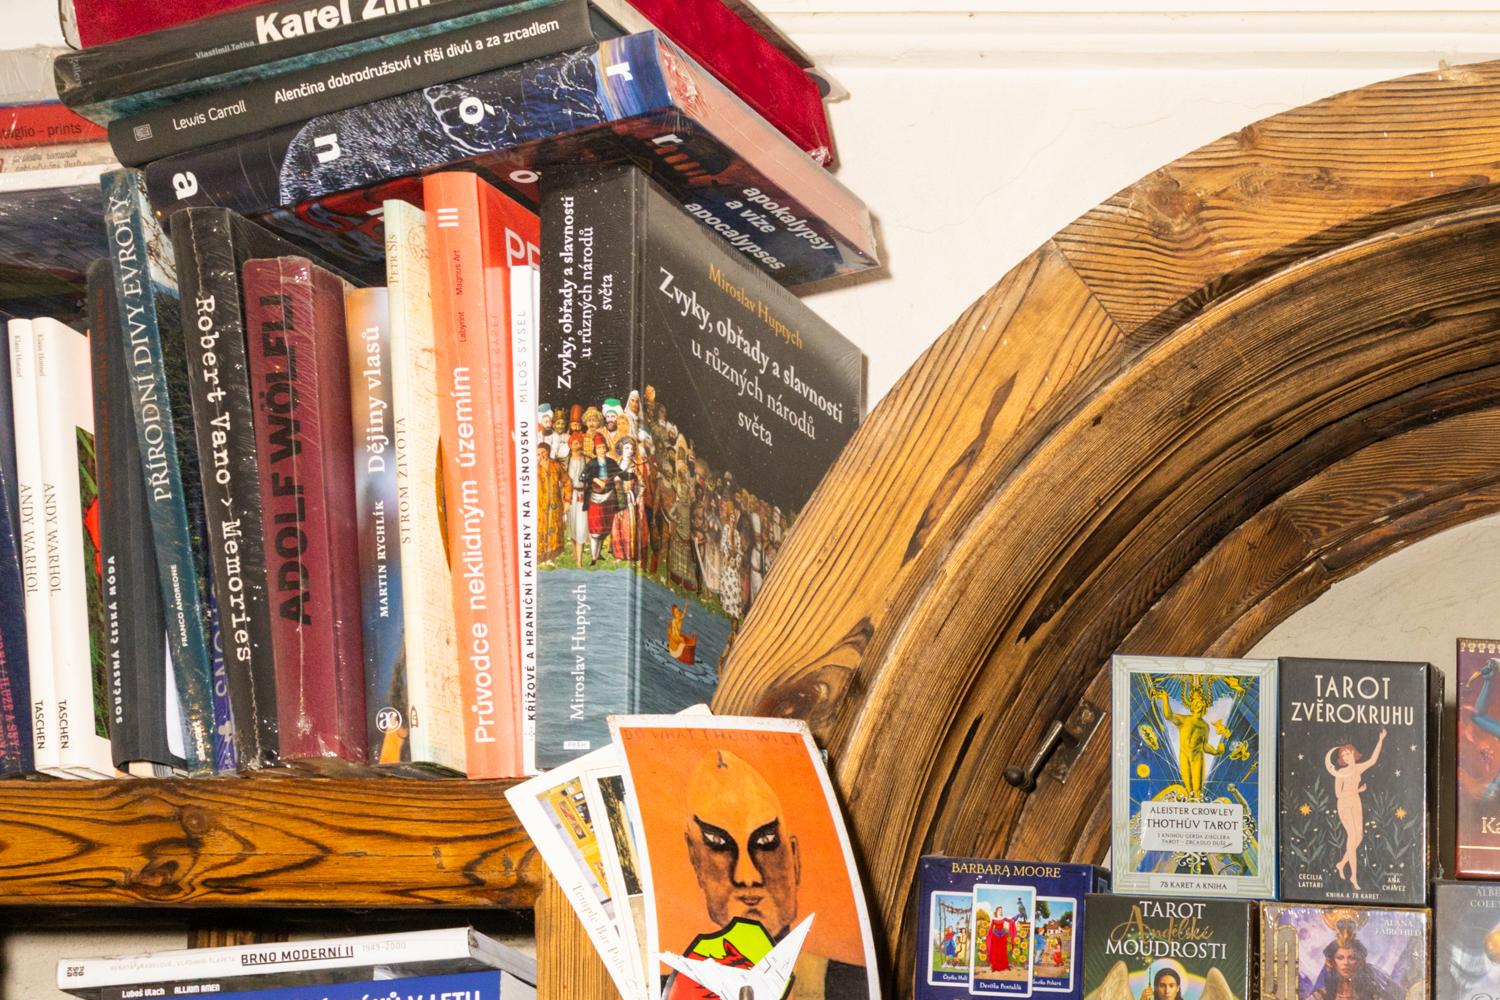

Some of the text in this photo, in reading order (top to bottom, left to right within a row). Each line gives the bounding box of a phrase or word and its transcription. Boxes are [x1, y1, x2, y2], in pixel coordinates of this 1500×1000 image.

[255, 0, 352, 45] Karel
[274, 19, 560, 104] Alenčina dobrodružství v říši divů a za zrcadlem
[172, 100, 247, 131] Lewis Carroll
[658, 266, 845, 424] Zvyky, obřady a slavnosti
[708, 262, 803, 349] Miroslav Huptych
[108, 196, 173, 503] PŘÍRODNÍ DIVY EVROPY
[358, 325, 391, 475] Dějiny vlasů
[195, 295, 252, 663] Robert Vano Memories
[269, 483, 312, 627] ADOLF
[370, 499, 389, 618] MARTIN RYCHLÍK
[454, 366, 496, 745] Průvodce neklidným územím
[519, 420, 537, 721] KŘÍŽOVÉ A HRANIČNÍ KAMENY NA TIŠNOVSKU
[34, 700, 47, 750] TASCHEN
[1290, 699, 1416, 727] ZVĚROKRUHU
[1314, 674, 1391, 700] TAROT
[1146, 815, 1239, 832] THOTHŮV TAROT
[1150, 805, 1235, 818] ALEISTER CROWLEY
[1104, 937, 1228, 960] MOUDROSTI
[1139, 900, 1206, 921] TAROT
